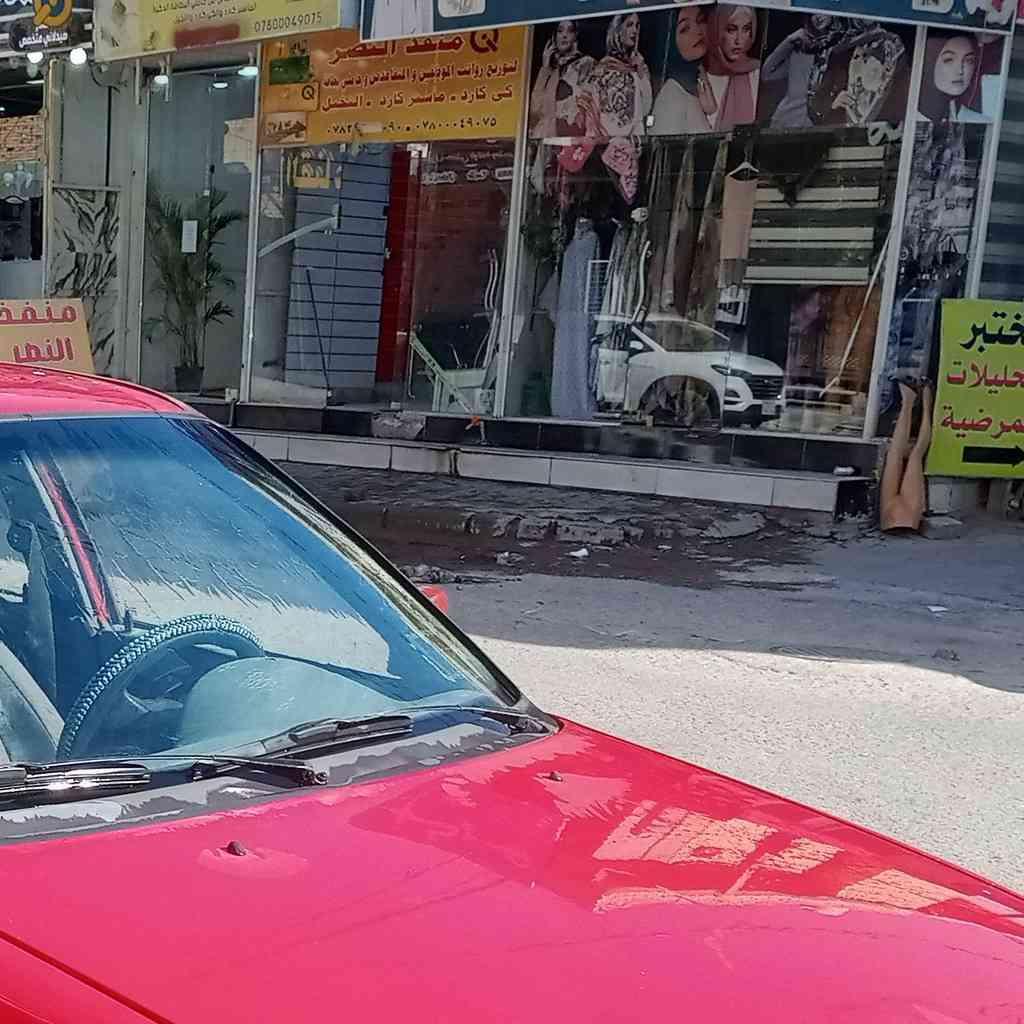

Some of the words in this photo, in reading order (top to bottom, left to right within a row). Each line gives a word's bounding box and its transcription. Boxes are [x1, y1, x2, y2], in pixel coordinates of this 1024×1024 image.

[457, 64, 484, 79] رواتب
[486, 60, 518, 79] لتوزيع
[460, 85, 487, 104] كارد
[960, 311, 1024, 353] ختبر
[946, 360, 1024, 395] حليلات
[941, 404, 1024, 439] مرضية
